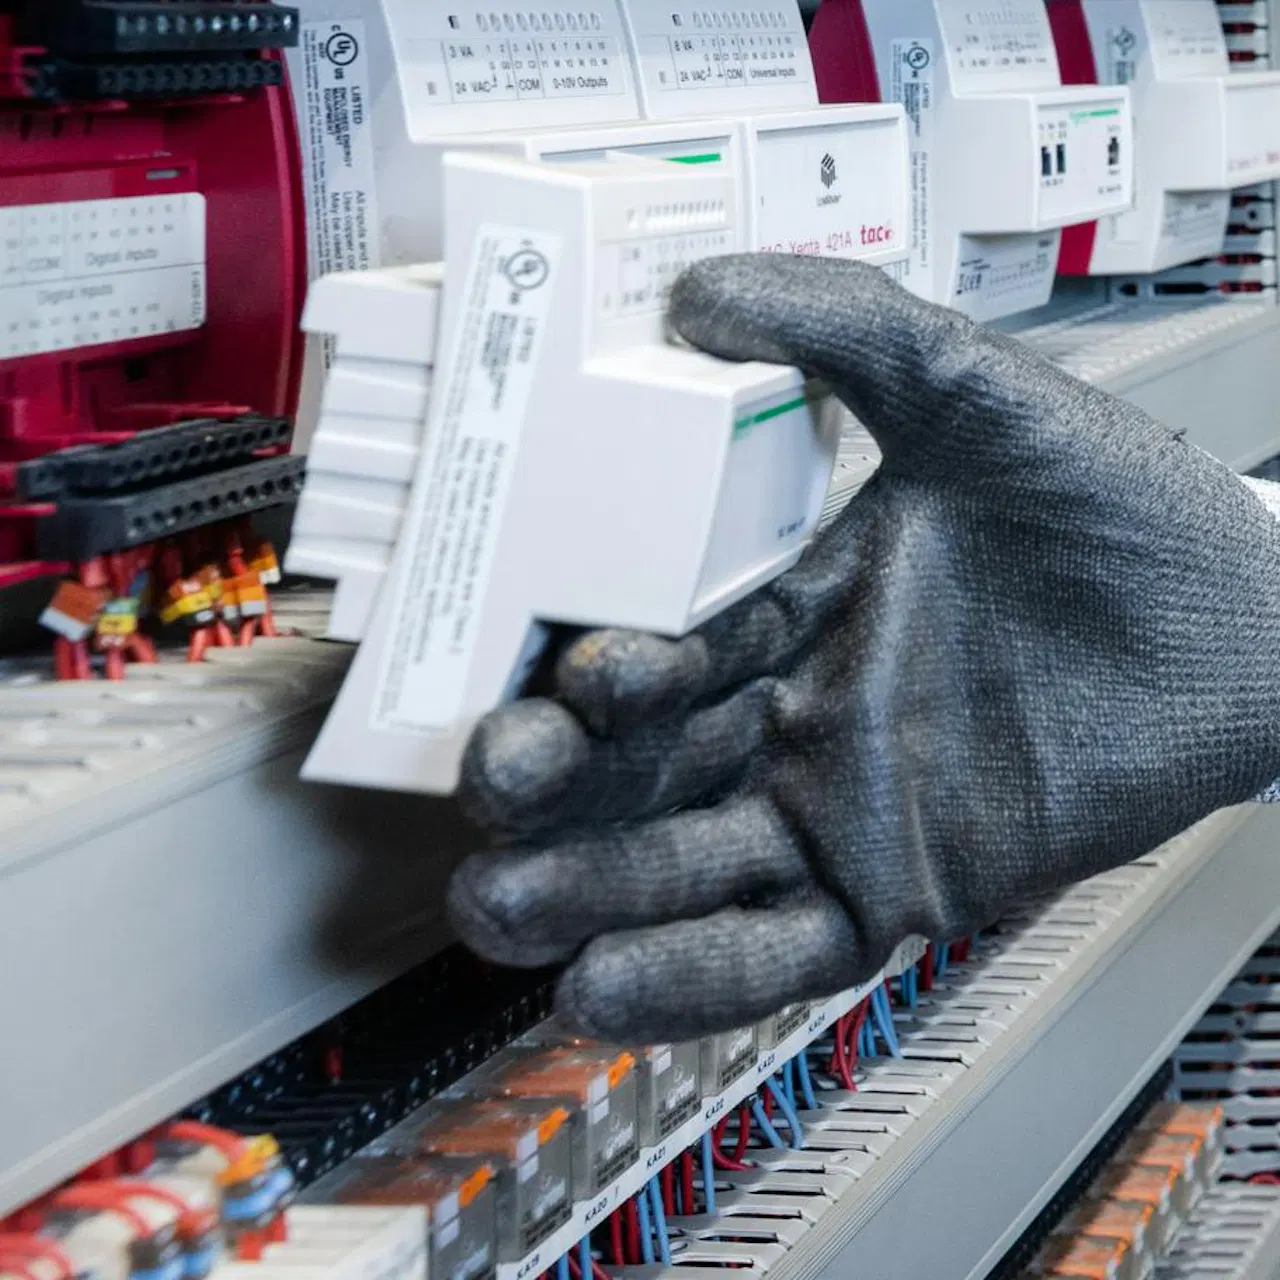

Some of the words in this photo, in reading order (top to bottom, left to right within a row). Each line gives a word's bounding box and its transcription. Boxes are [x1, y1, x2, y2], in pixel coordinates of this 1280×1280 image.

[332, 39, 351, 59] UL
[459, 45, 475, 58] VA
[682, 40, 693, 52] VA
[552, 77, 575, 89] 0-10V
[577, 76, 608, 89] Outputs
[680, 72, 689, 82] 24
[691, 70, 707, 82] VAC
[727, 68, 743, 80] COM
[750, 67, 777, 78] Universal
[455, 82, 467, 94] 24
[472, 80, 491, 93] VAC
[518, 78, 540, 91] COM
[351, 86, 364, 124] LISTED
[342, 133, 353, 168] ENERGY
[330, 192, 341, 214] May
[343, 190, 353, 212] Use
[355, 206, 367, 238] inputs
[343, 215, 354, 252] copper
[826, 230, 852, 252] 421A
[860, 224, 884, 245] tac
[333, 233, 344, 260] used
[359, 241, 370, 262] and
[645, 1145, 667, 1170] KA21
[583, 1196, 608, 1224] KA20
